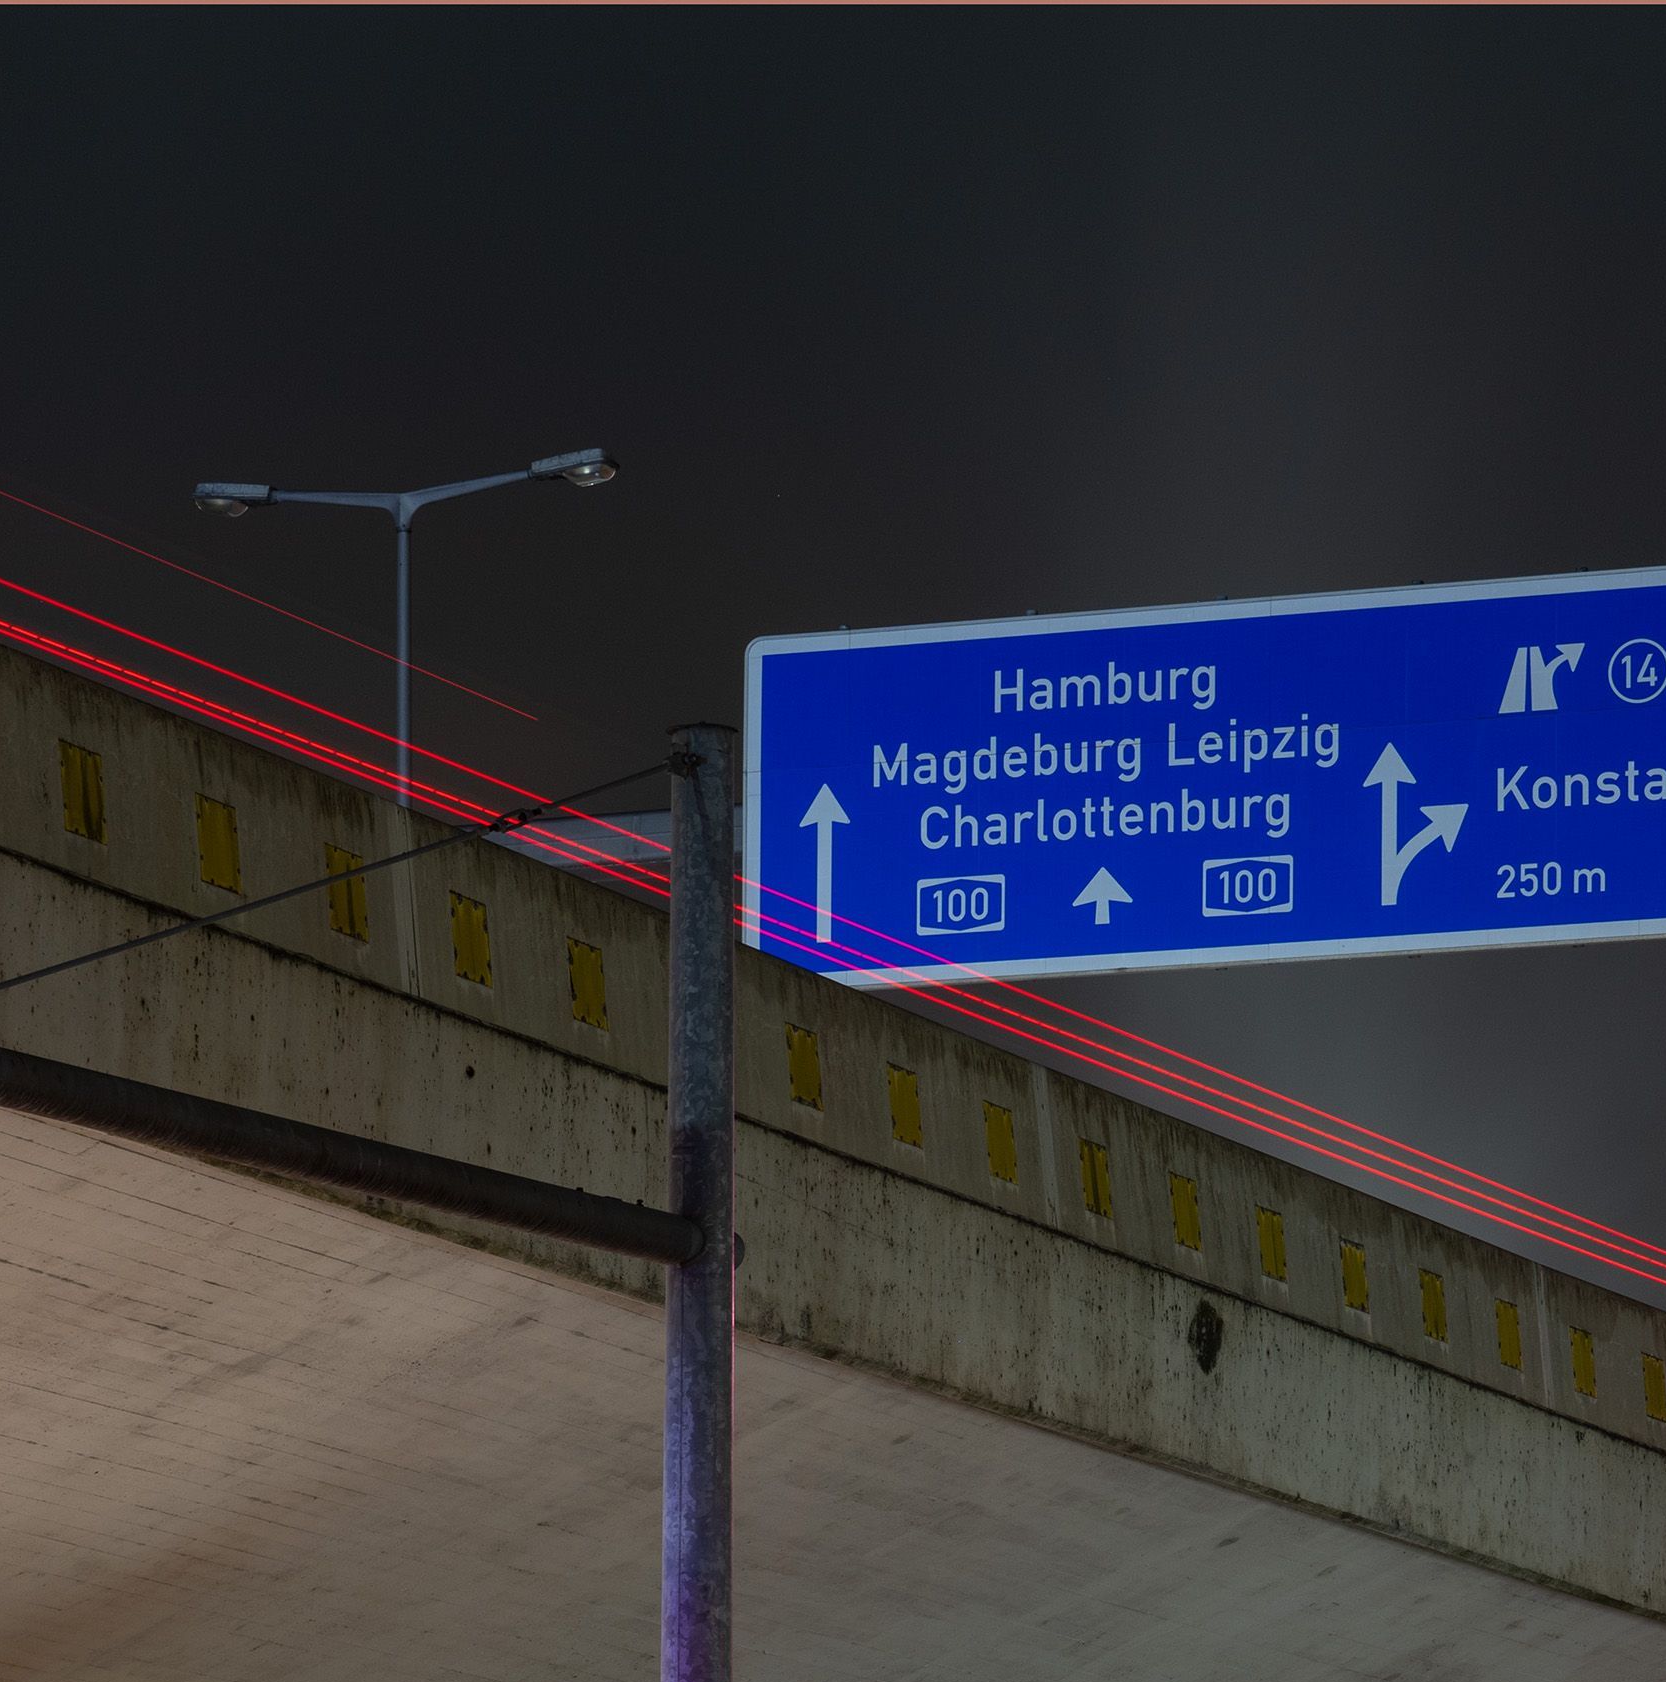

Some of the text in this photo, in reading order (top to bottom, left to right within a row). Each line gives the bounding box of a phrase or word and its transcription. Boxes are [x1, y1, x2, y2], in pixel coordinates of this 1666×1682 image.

[994, 661, 1217, 714] Hamburg
[1620, 653, 1659, 689] 14
[873, 713, 1340, 794] Magdeburg Leipzig
[920, 788, 1291, 850] Charlottenburg
[1219, 868, 1277, 904] 100
[1496, 861, 1606, 898] 250 m
[932, 887, 989, 923] 100
